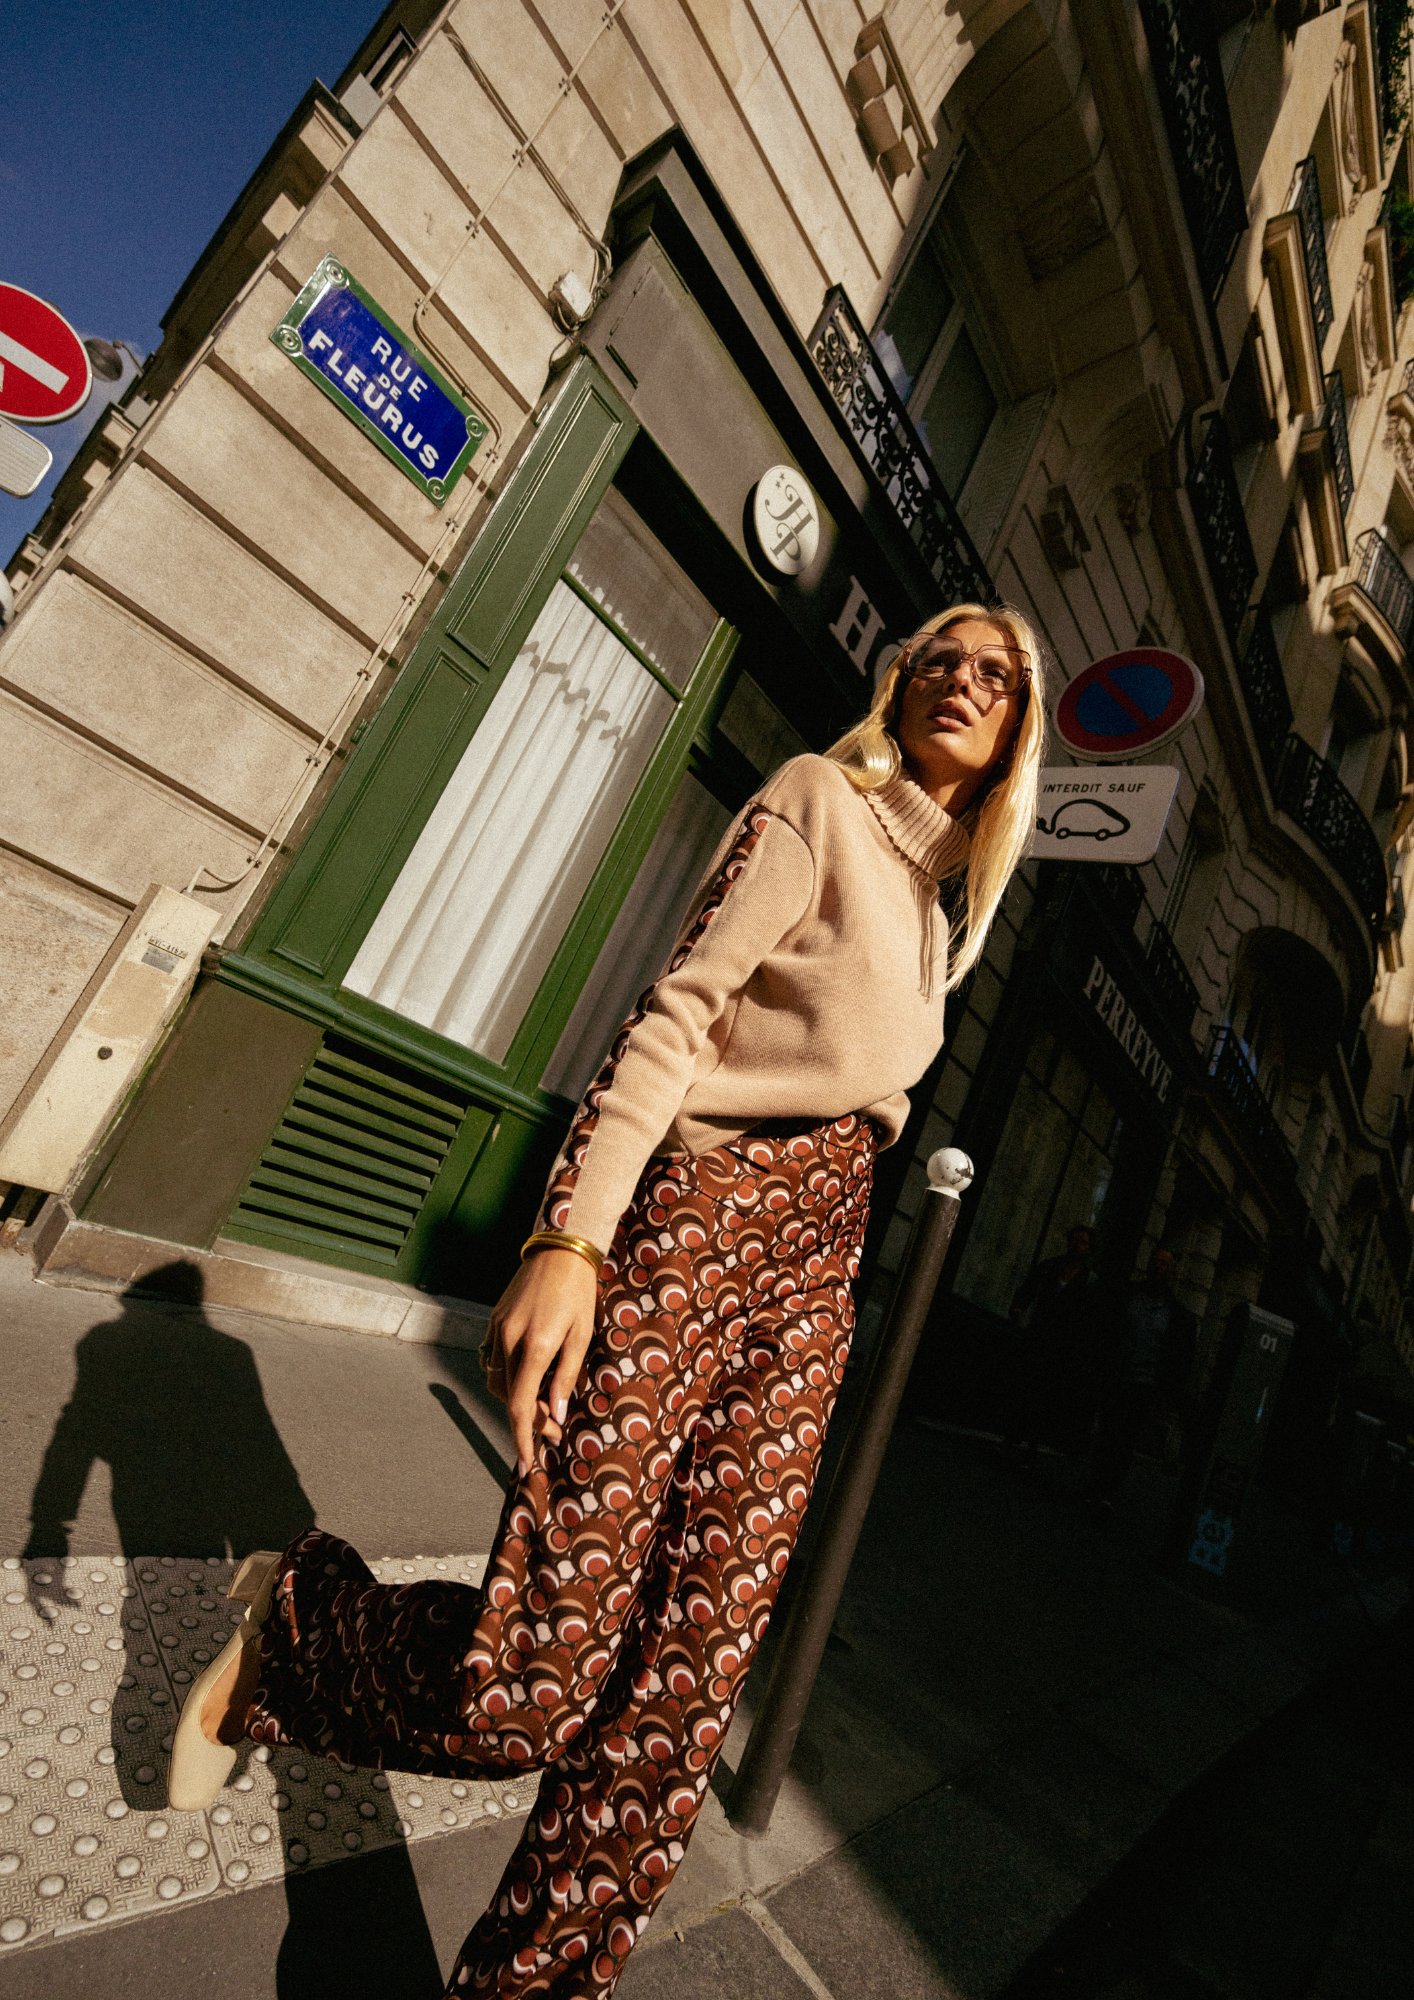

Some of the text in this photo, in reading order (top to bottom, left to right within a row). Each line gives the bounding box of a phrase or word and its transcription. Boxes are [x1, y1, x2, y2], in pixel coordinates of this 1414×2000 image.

[370, 335, 429, 403] RUE
[378, 374, 402, 401] DE
[308, 329, 441, 471] FLEURUS
[1043, 783, 1146, 793] INTERDIT SAUF
[1082, 955, 1172, 1104] PERREYVE
[1259, 1333, 1278, 1355] 01
